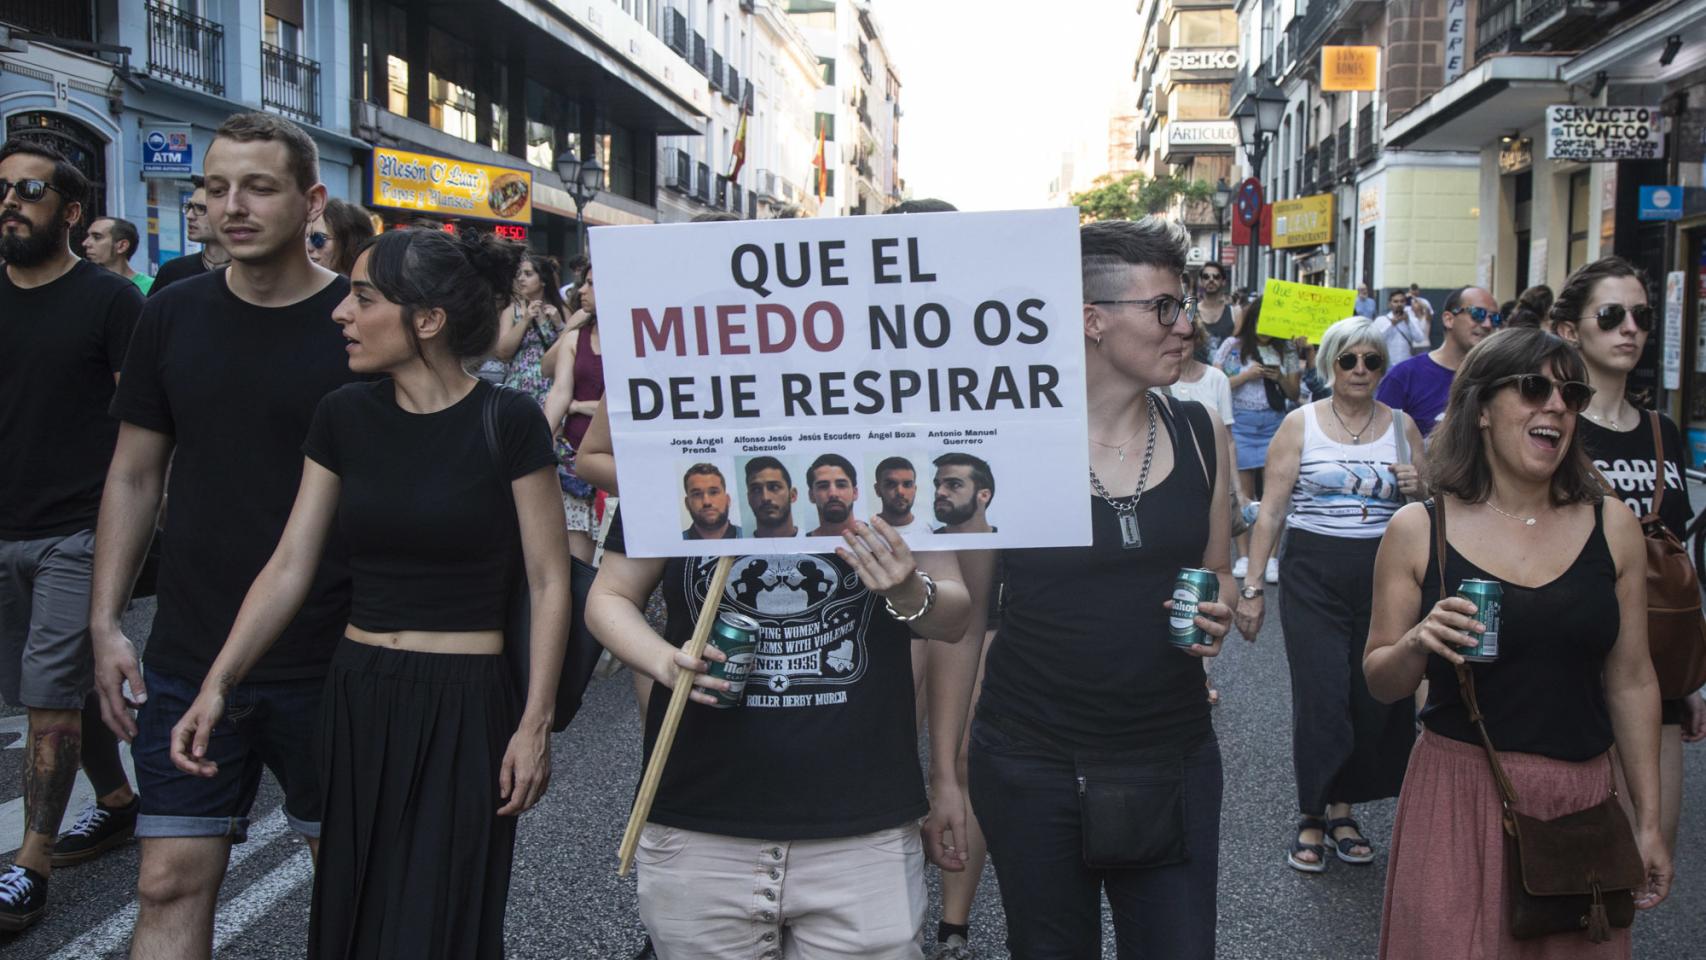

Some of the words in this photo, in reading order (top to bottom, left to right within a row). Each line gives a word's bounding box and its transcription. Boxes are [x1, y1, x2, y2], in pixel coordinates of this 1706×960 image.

[1169, 51, 1240, 70] SEIKO
[56, 82, 68, 100] 15
[1553, 107, 1649, 123] SERVICIO
[1562, 124, 1650, 139] TECNICO
[152, 151, 182, 163] ATM
[731, 240, 848, 298] QUE
[872, 237, 936, 284] EL
[631, 301, 844, 358] MIEDO
[869, 303, 951, 350] NO
[974, 298, 1048, 346] OS
[628, 375, 760, 421] DEJE
[781, 364, 1063, 417] RESPIRAR
[734, 435, 765, 443] Alfonso
[767, 434, 793, 443] Jesús
[798, 432, 822, 442] Jesús
[823, 432, 861, 441] Escudero
[868, 430, 893, 440] Ángel
[894, 431, 916, 439] Boza
[928, 429, 962, 438] Antonio
[964, 428, 998, 436] Manuel
[943, 437, 983, 445] Guerrero
[682, 446, 717, 454] Prenda
[742, 443, 786, 452] Cabezuelo
[783, 621, 821, 640] WOMEN
[785, 638, 812, 653] WITH
[813, 619, 856, 648] VIOLENCE
[787, 654, 817, 670] 1935
[746, 694, 780, 707] ROLLER
[782, 694, 814, 707] DERBY
[815, 690, 848, 706] MURCIA
